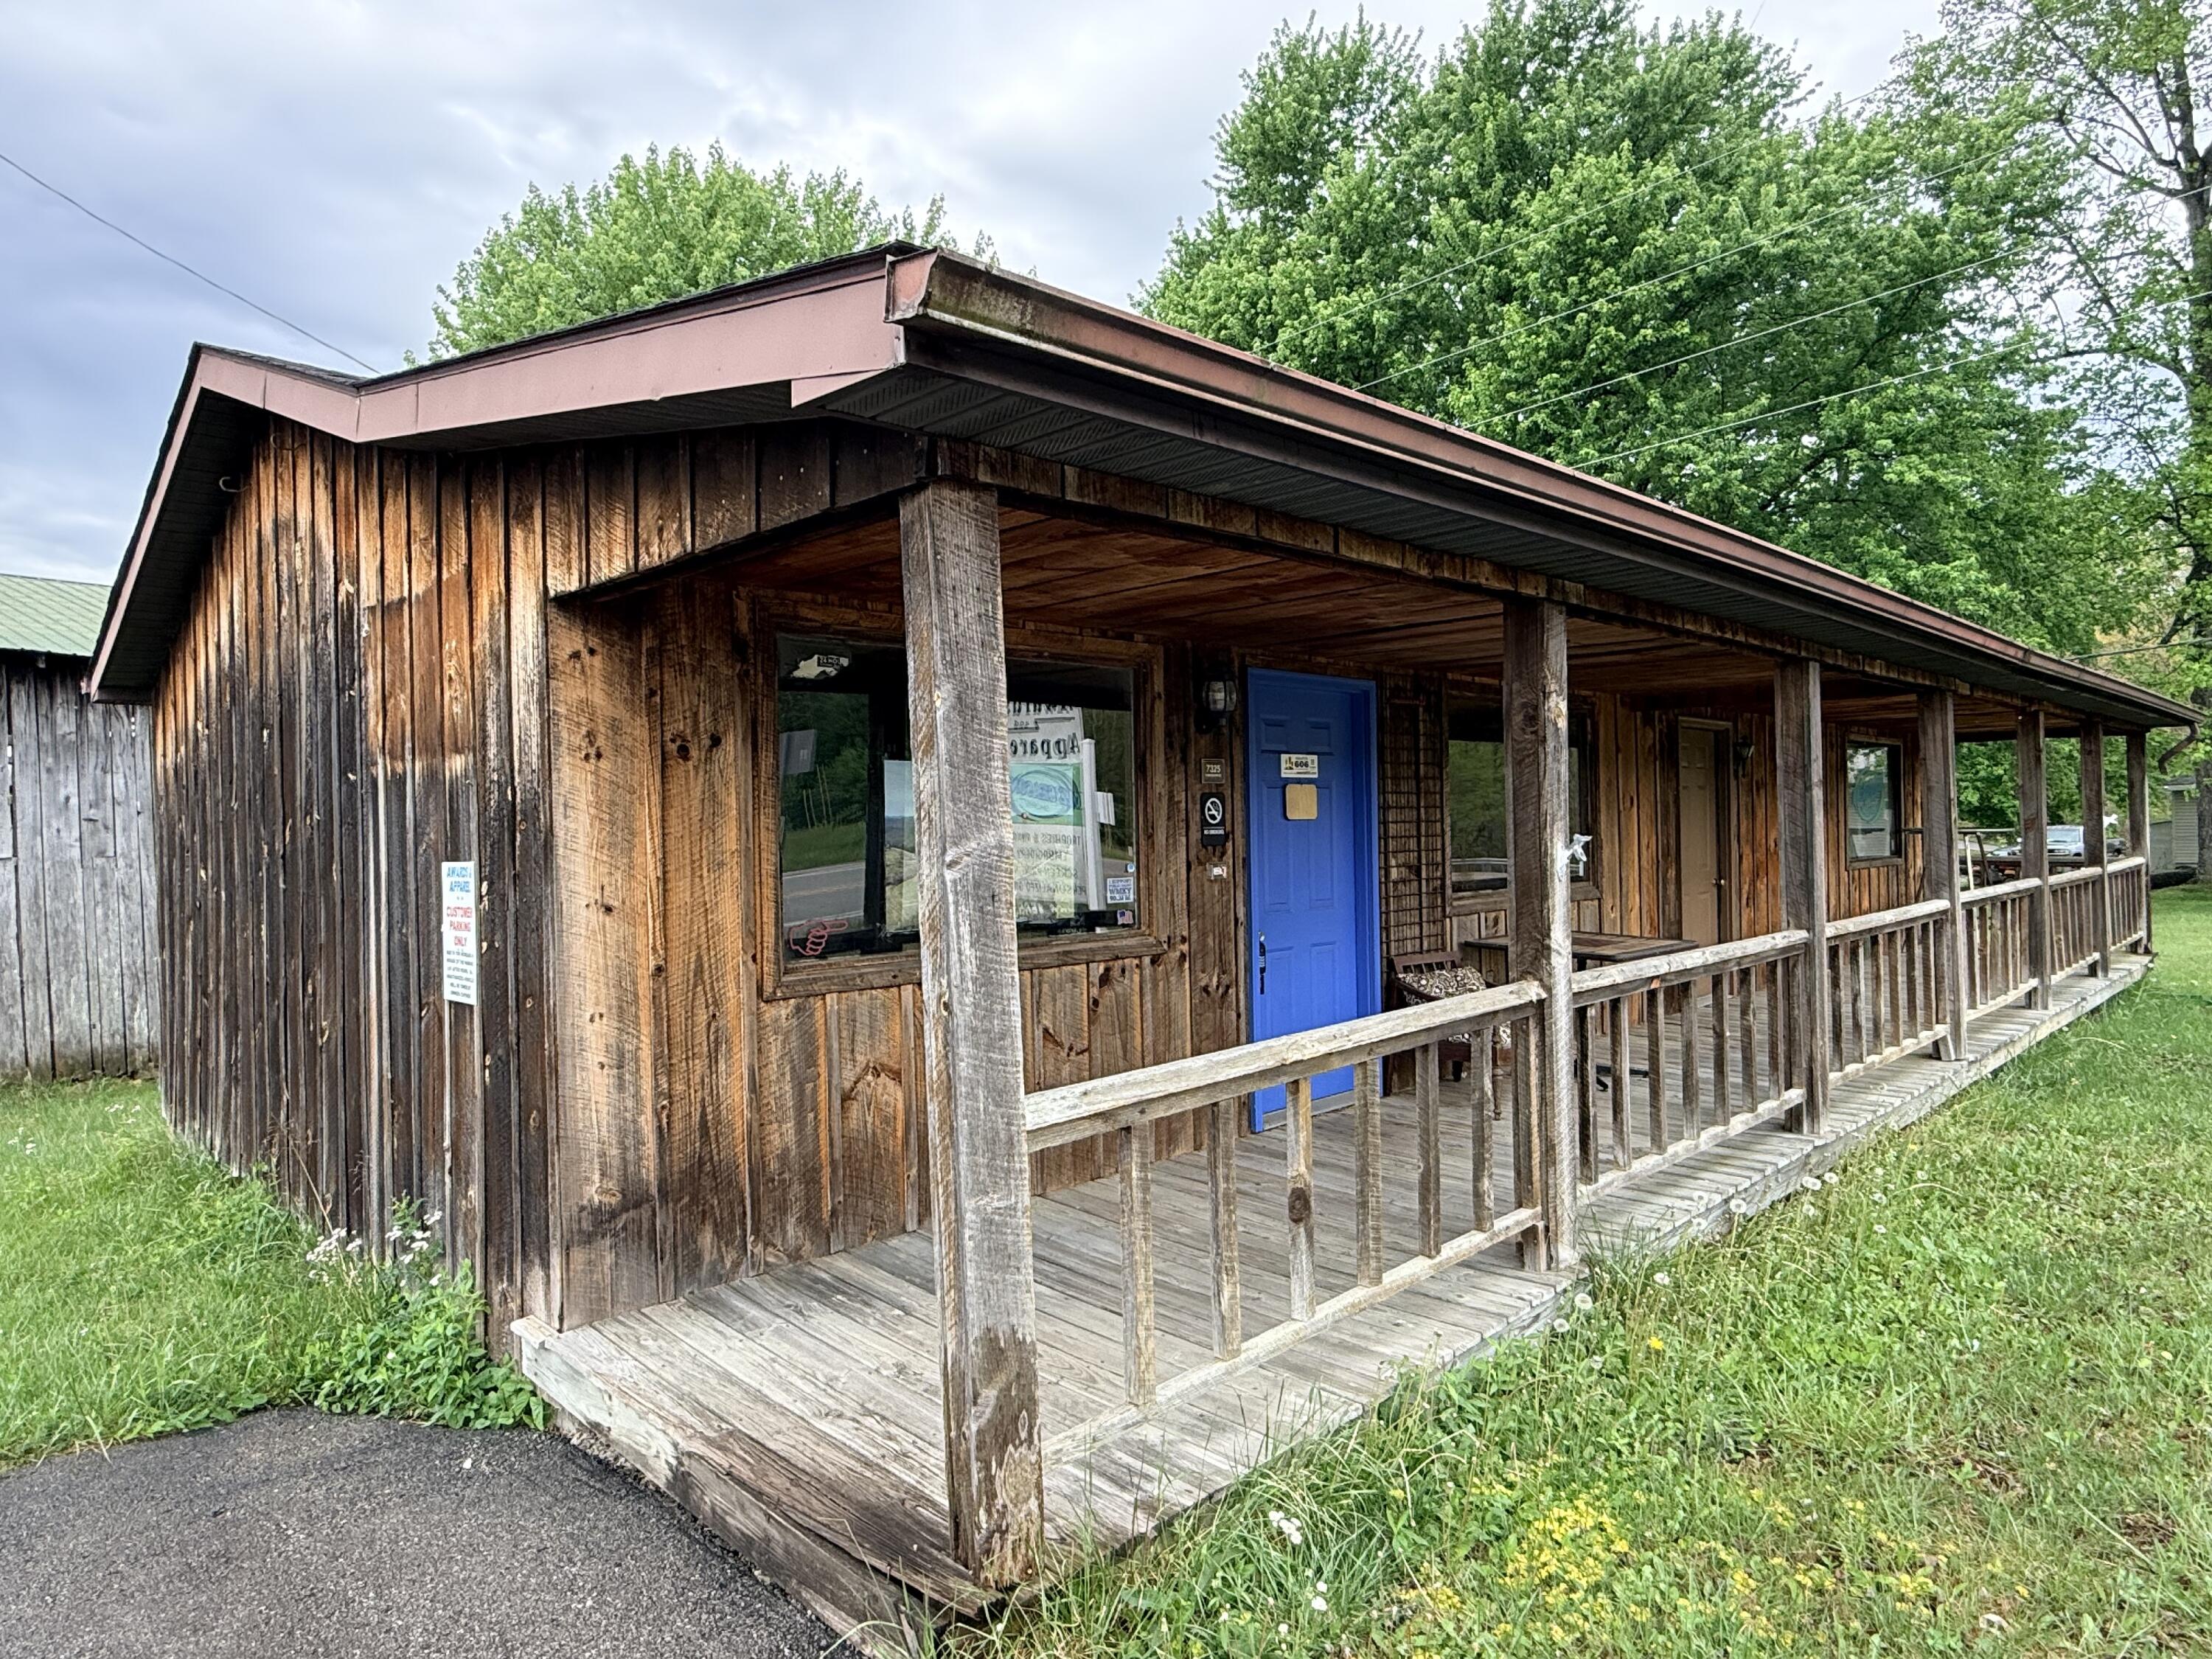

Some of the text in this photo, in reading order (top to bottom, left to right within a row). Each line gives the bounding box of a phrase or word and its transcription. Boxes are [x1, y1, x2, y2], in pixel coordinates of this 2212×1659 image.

[1206, 765, 1222, 773] 7325
[1294, 760, 1310, 768] 606
[447, 866, 467, 878] AWARDS
[449, 880, 471, 893] APPAREL
[446, 905, 473, 919] CUSTOMER
[450, 919, 471, 932] PARKING
[454, 936, 467, 947] ONLY
